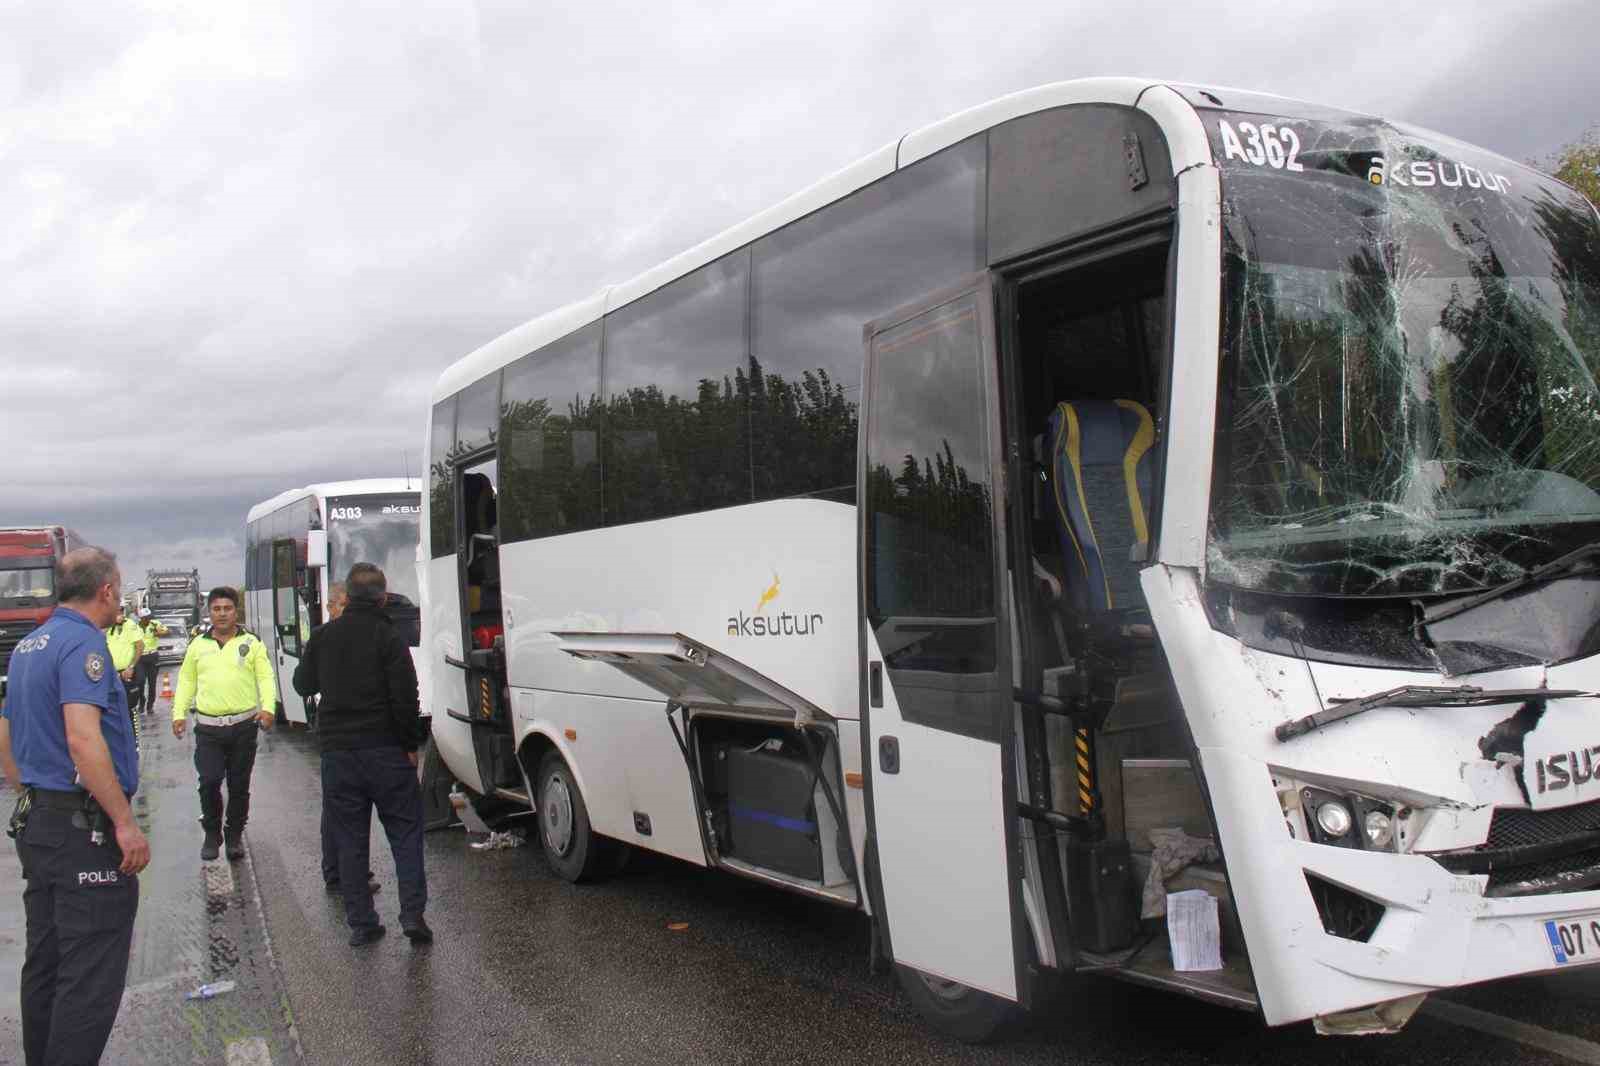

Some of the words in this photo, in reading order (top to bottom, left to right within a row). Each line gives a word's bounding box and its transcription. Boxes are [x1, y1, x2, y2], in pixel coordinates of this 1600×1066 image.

[1219, 119, 1304, 172] A362
[1368, 156, 1512, 194] aksutur
[331, 507, 362, 520] A303
[727, 609, 824, 637] aksutur
[1558, 922, 1585, 957] 07
